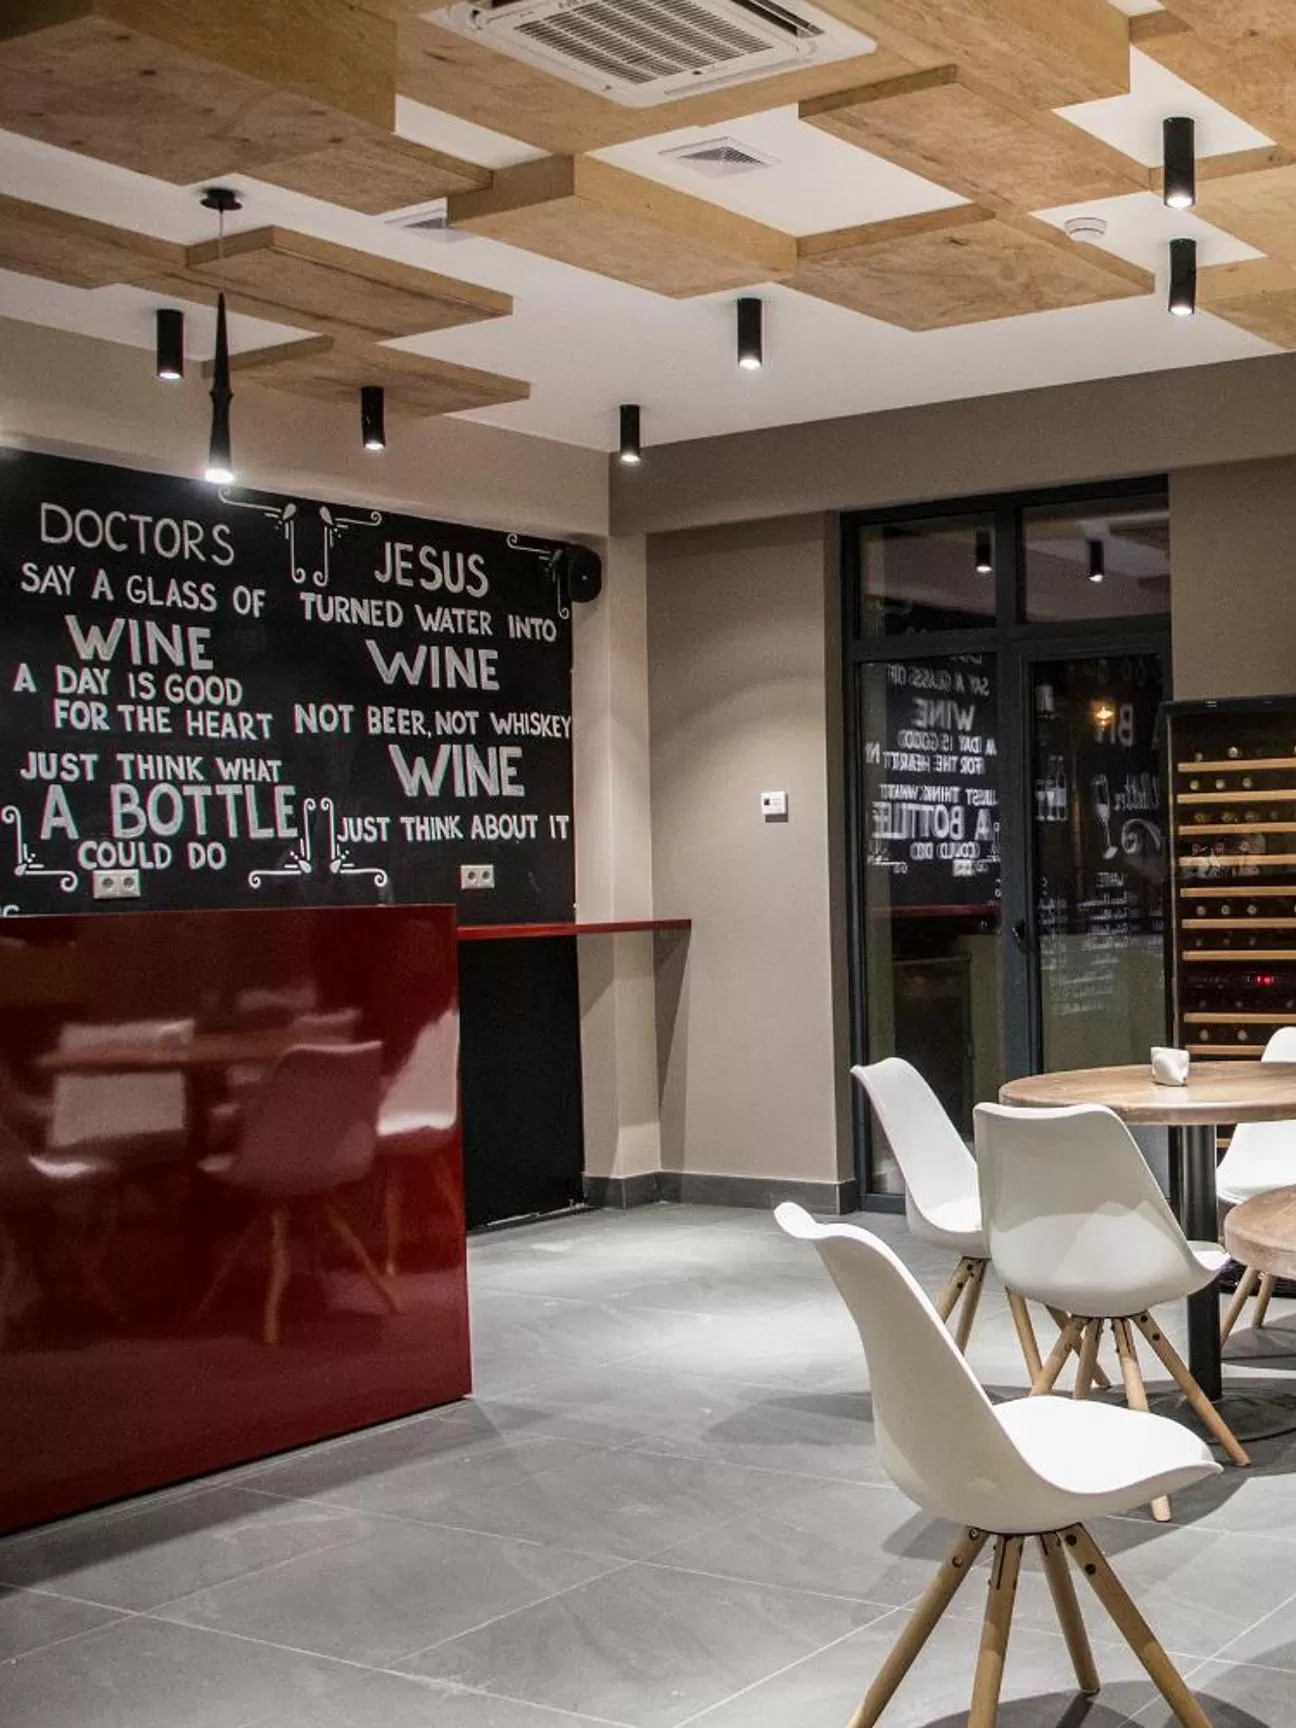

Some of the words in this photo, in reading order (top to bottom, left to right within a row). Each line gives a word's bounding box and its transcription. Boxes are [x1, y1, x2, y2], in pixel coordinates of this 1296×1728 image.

[39, 502, 235, 566] DOCTORS
[21, 562, 76, 596] SAY
[91, 569, 114, 601] A
[126, 574, 218, 612] GLASS
[232, 585, 266, 618] OF
[374, 540, 489, 598] JESUS
[299, 591, 404, 628] TURNED
[414, 604, 493, 636] WATER
[508, 614, 557, 642] INTO
[64, 614, 214, 671] WINE
[365, 639, 500, 691] WINE
[13, 662, 37, 693] A
[55, 664, 111, 696] DAY
[128, 671, 157, 701] IS
[164, 673, 243, 707] GOOD
[53, 698, 111, 731] FOR
[116, 704, 173, 734] THE
[185, 709, 273, 741] HEART
[294, 702, 354, 734] NOT
[434, 710, 480, 736] NOT
[489, 711, 572, 739] WHISKEY
[19, 751, 99, 782] JUST
[115, 753, 205, 782] THINK
[214, 756, 283, 783] WHAT
[388, 743, 525, 798] WINE
[40, 784, 80, 840] A
[110, 782, 298, 840] BOTTLE
[336, 815, 391, 843] JUST
[399, 815, 464, 843] THINK
[470, 813, 539, 841] ABOUT
[549, 814, 570, 840] IT
[77, 840, 173, 871] COULD
[187, 841, 227, 871] DO
